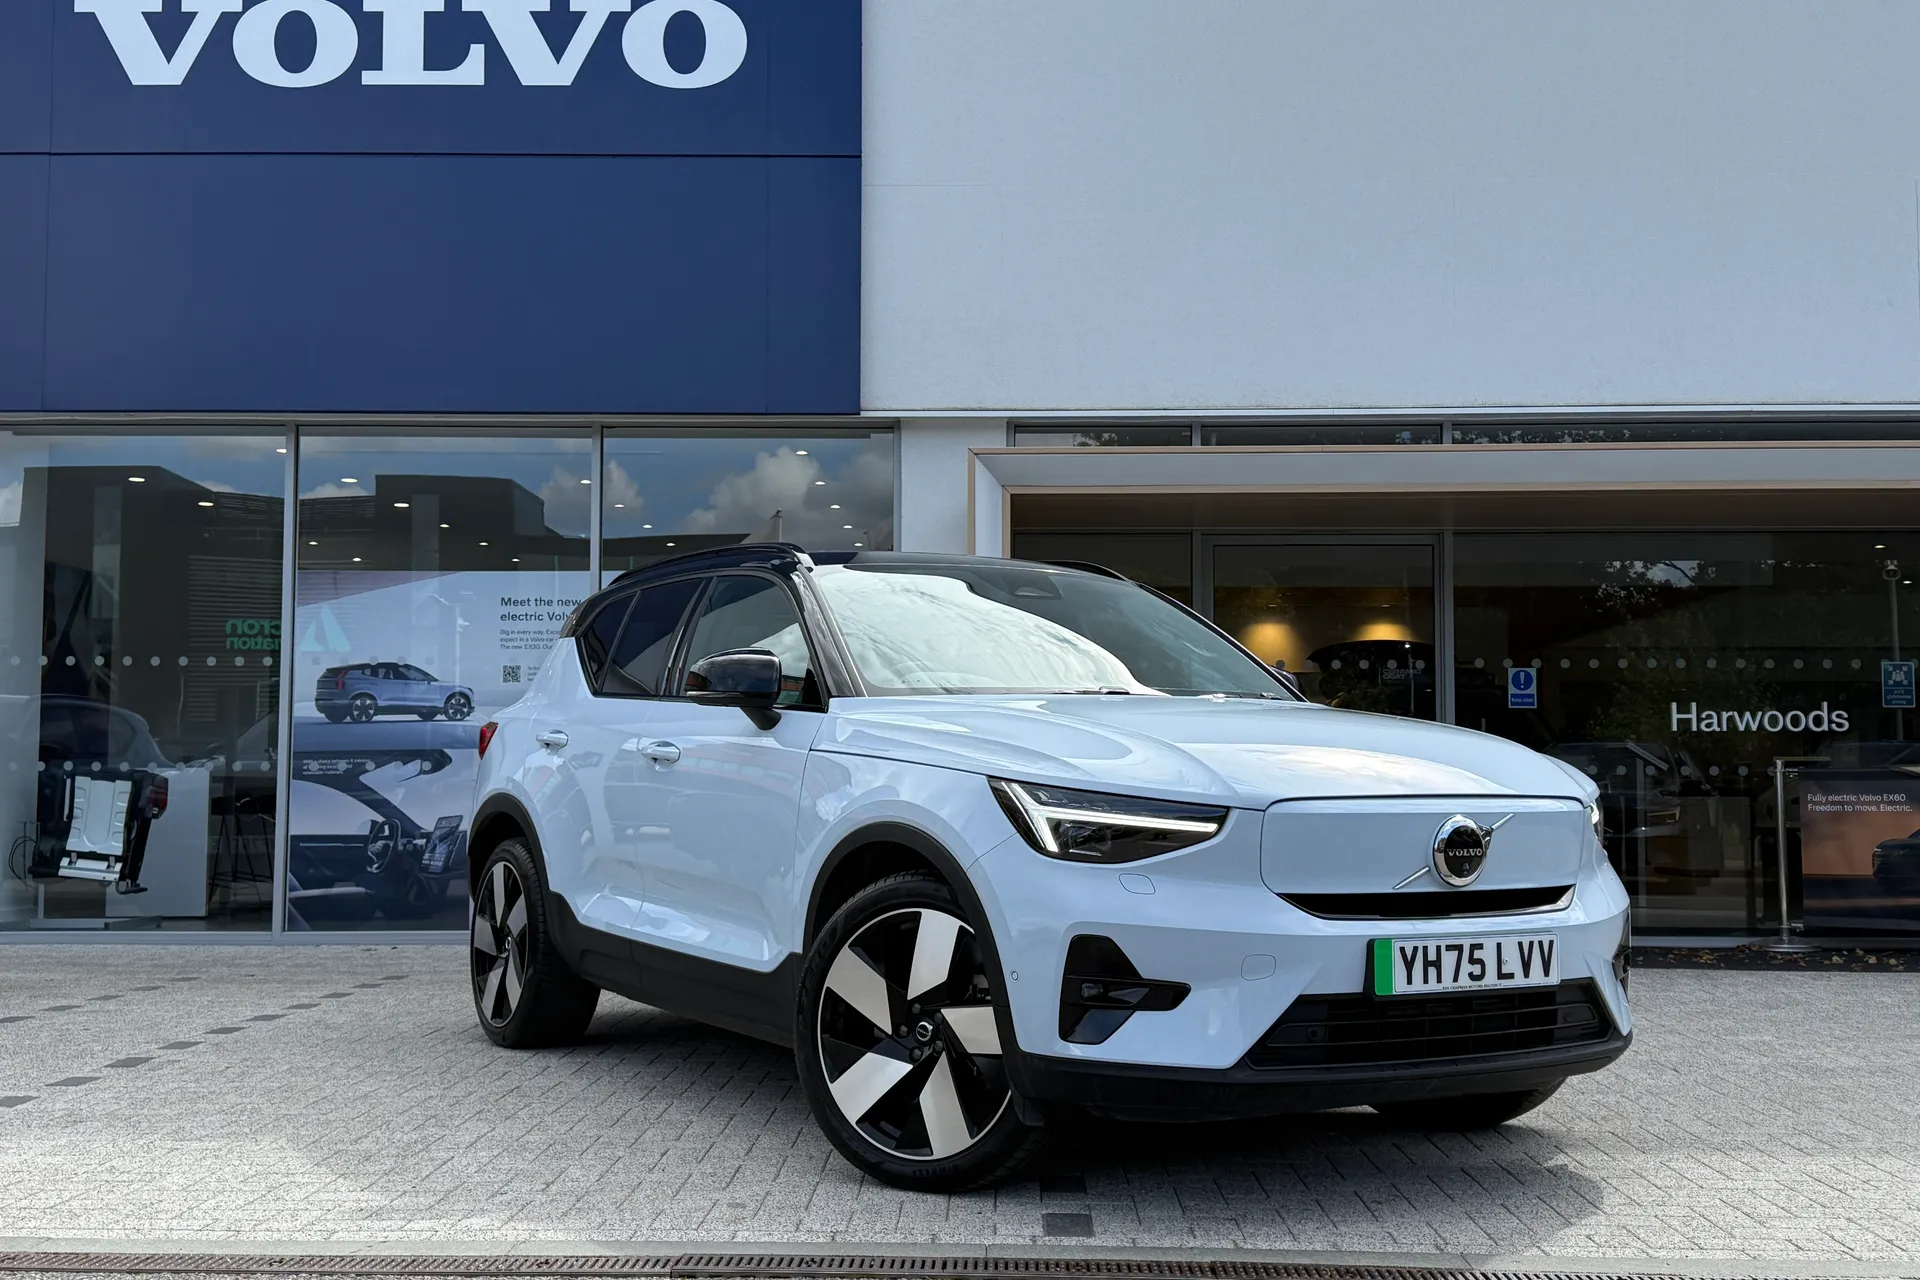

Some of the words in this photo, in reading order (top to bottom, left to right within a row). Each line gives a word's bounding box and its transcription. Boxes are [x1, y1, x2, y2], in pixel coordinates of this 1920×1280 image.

[74, 0, 748, 89] VOLVO
[500, 597, 531, 607] Meet
[534, 597, 554, 607] the
[500, 611, 544, 621] electric
[1670, 701, 1850, 732] Harwoods
[1807, 793, 1826, 803] Fully
[1828, 793, 1857, 802] electric
[1859, 793, 1881, 802] Volvo
[1883, 793, 1906, 802] EX60
[1808, 804, 1843, 812] Freedom
[1844, 804, 1853, 812] to
[1880, 804, 1913, 812] Electric.
[1446, 848, 1483, 857] VOLVO
[1399, 942, 1486, 985] YH75
[1496, 939, 1555, 980] LVV
